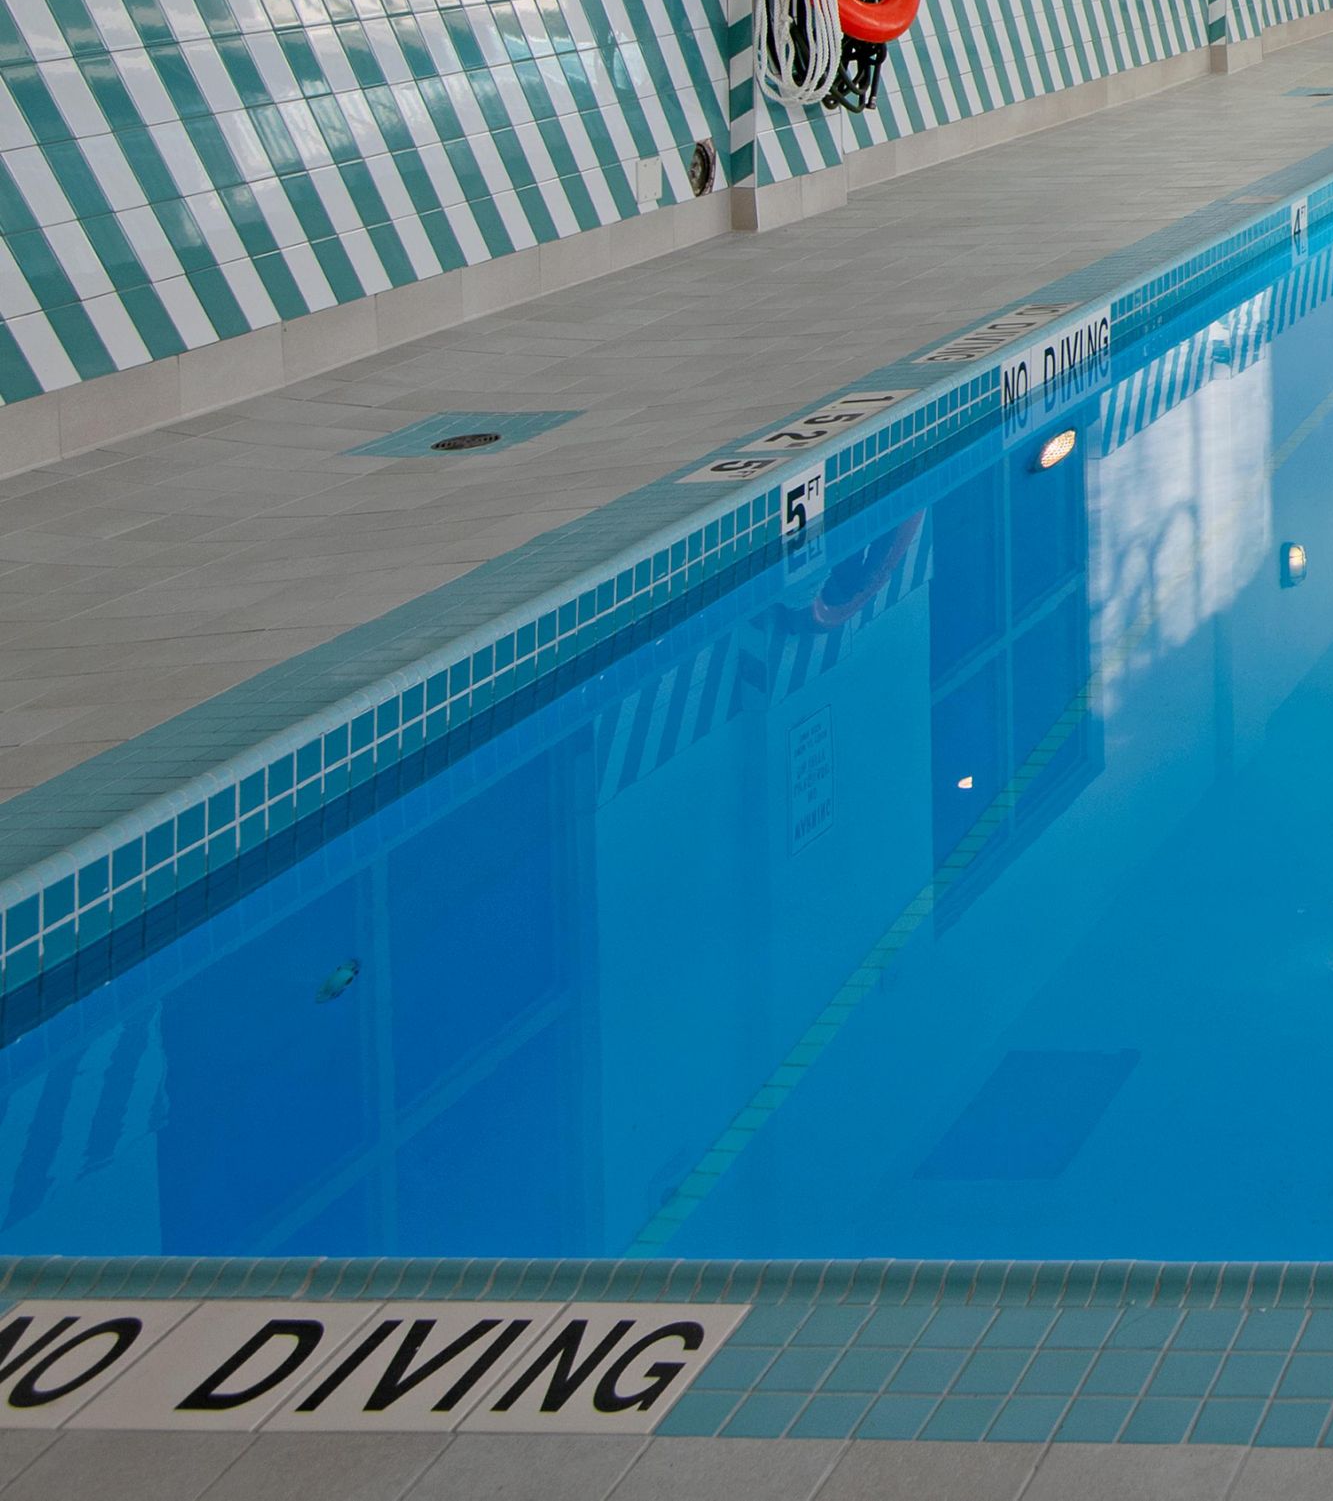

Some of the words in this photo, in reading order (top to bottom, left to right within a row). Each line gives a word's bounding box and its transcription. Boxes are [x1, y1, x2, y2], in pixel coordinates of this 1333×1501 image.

[928, 322, 1036, 361] DIVING
[1003, 361, 1028, 408] NO
[1044, 317, 1109, 384] DIVING
[786, 483, 806, 536] 5
[807, 475, 822, 500] FT
[0, 1315, 143, 1410] NO
[173, 1317, 705, 1413] DIVING
